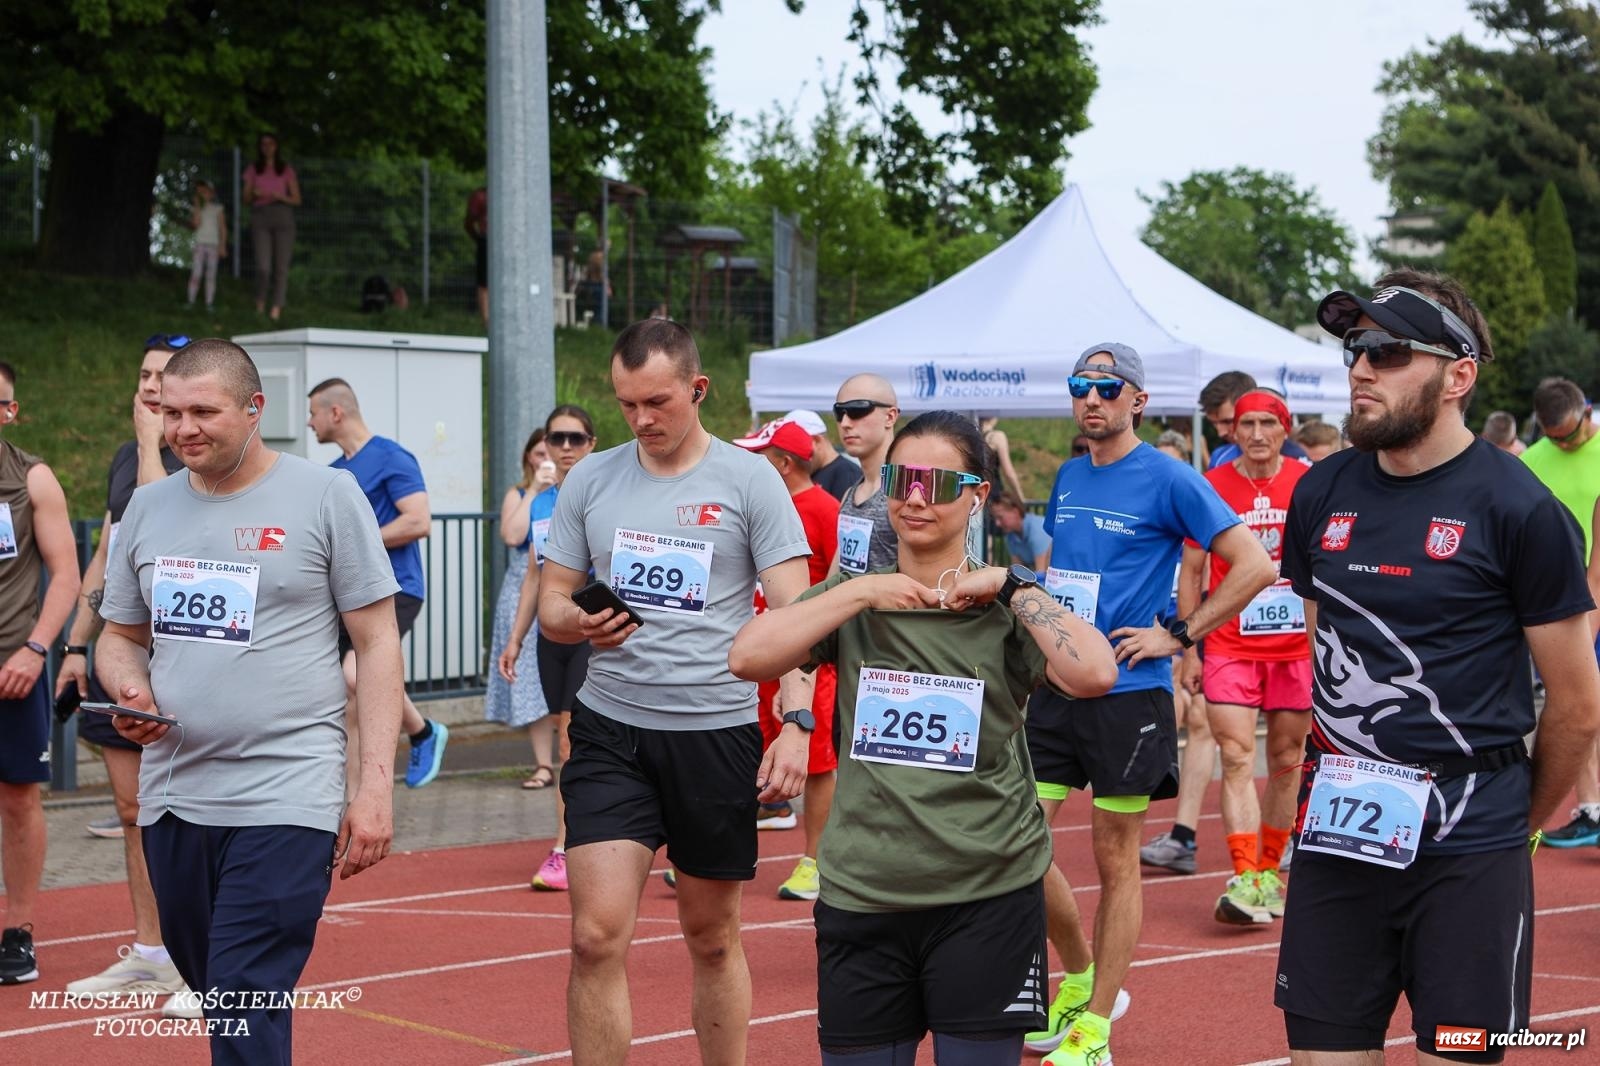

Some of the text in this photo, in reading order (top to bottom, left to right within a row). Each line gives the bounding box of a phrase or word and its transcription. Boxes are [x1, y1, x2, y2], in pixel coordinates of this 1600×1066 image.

[942, 367, 1026, 385] Wodociągi
[1432, 516, 1467, 527] RACIBÓRZ
[1103, 525, 1136, 536] MARATHON
[636, 533, 656, 543] BIEG
[657, 537, 672, 546] BEZ
[843, 537, 859, 557] 267
[639, 545, 655, 553] 2025
[161, 559, 175, 568] XVII
[176, 560, 196, 569] BIEG
[197, 561, 214, 571] BEZ
[215, 563, 252, 574] GRANIC
[180, 572, 194, 580] 2025
[628, 562, 684, 592] 269
[1069, 573, 1095, 582] GRANIC
[170, 591, 227, 621] 268
[1257, 605, 1289, 621] 168
[868, 671, 975, 690] XVII BIEG BEZ GRANIC
[872, 686, 890, 694] maja
[892, 687, 909, 695] 2025
[881, 708, 948, 743] 265
[1323, 756, 1335, 766] XVII
[1336, 758, 1355, 768] BIEG
[1357, 761, 1377, 772] BEZ
[1336, 773, 1353, 781] 2025
[1329, 796, 1383, 835] 172
